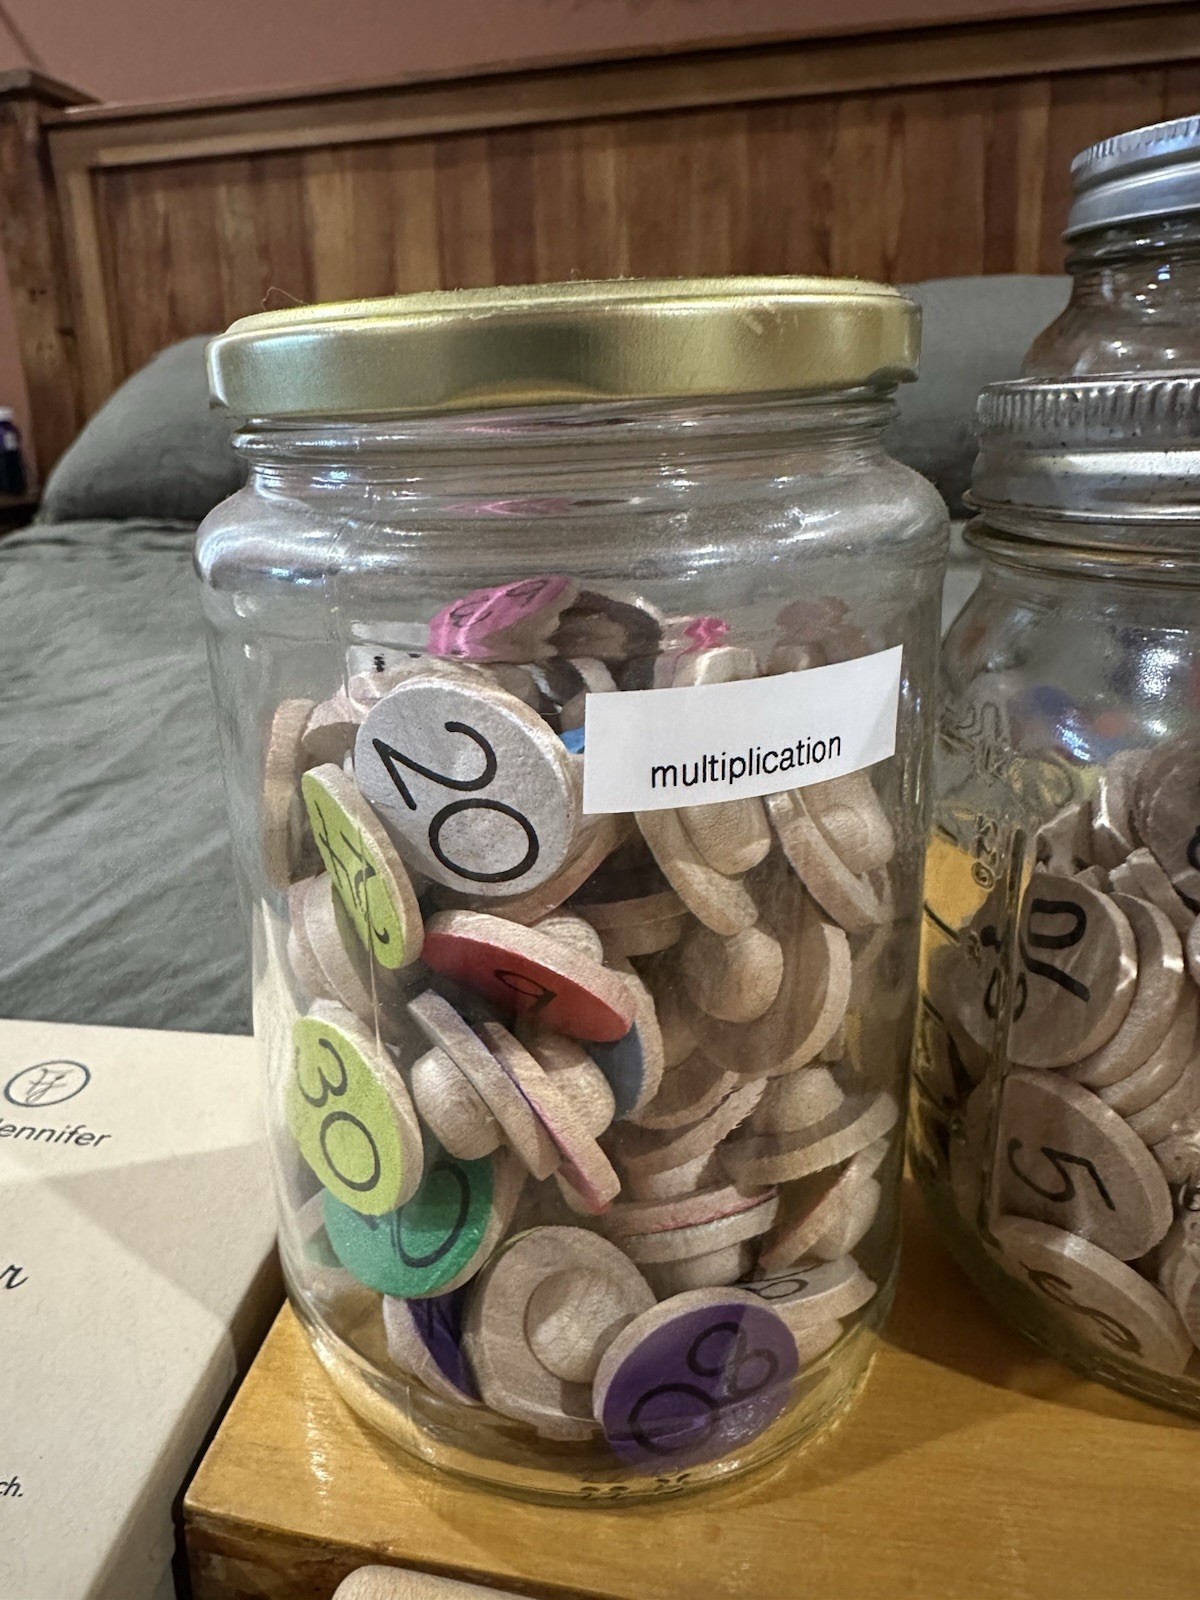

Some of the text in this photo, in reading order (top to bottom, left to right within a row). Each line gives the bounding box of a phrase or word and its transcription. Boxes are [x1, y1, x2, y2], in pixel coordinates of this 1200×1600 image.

[372, 721, 540, 883] 20
[651, 736, 841, 788] multiplication
[0, 1118, 112, 1147] ennifer
[296, 1037, 382, 1192] 30
[627, 1321, 779, 1455] 80
